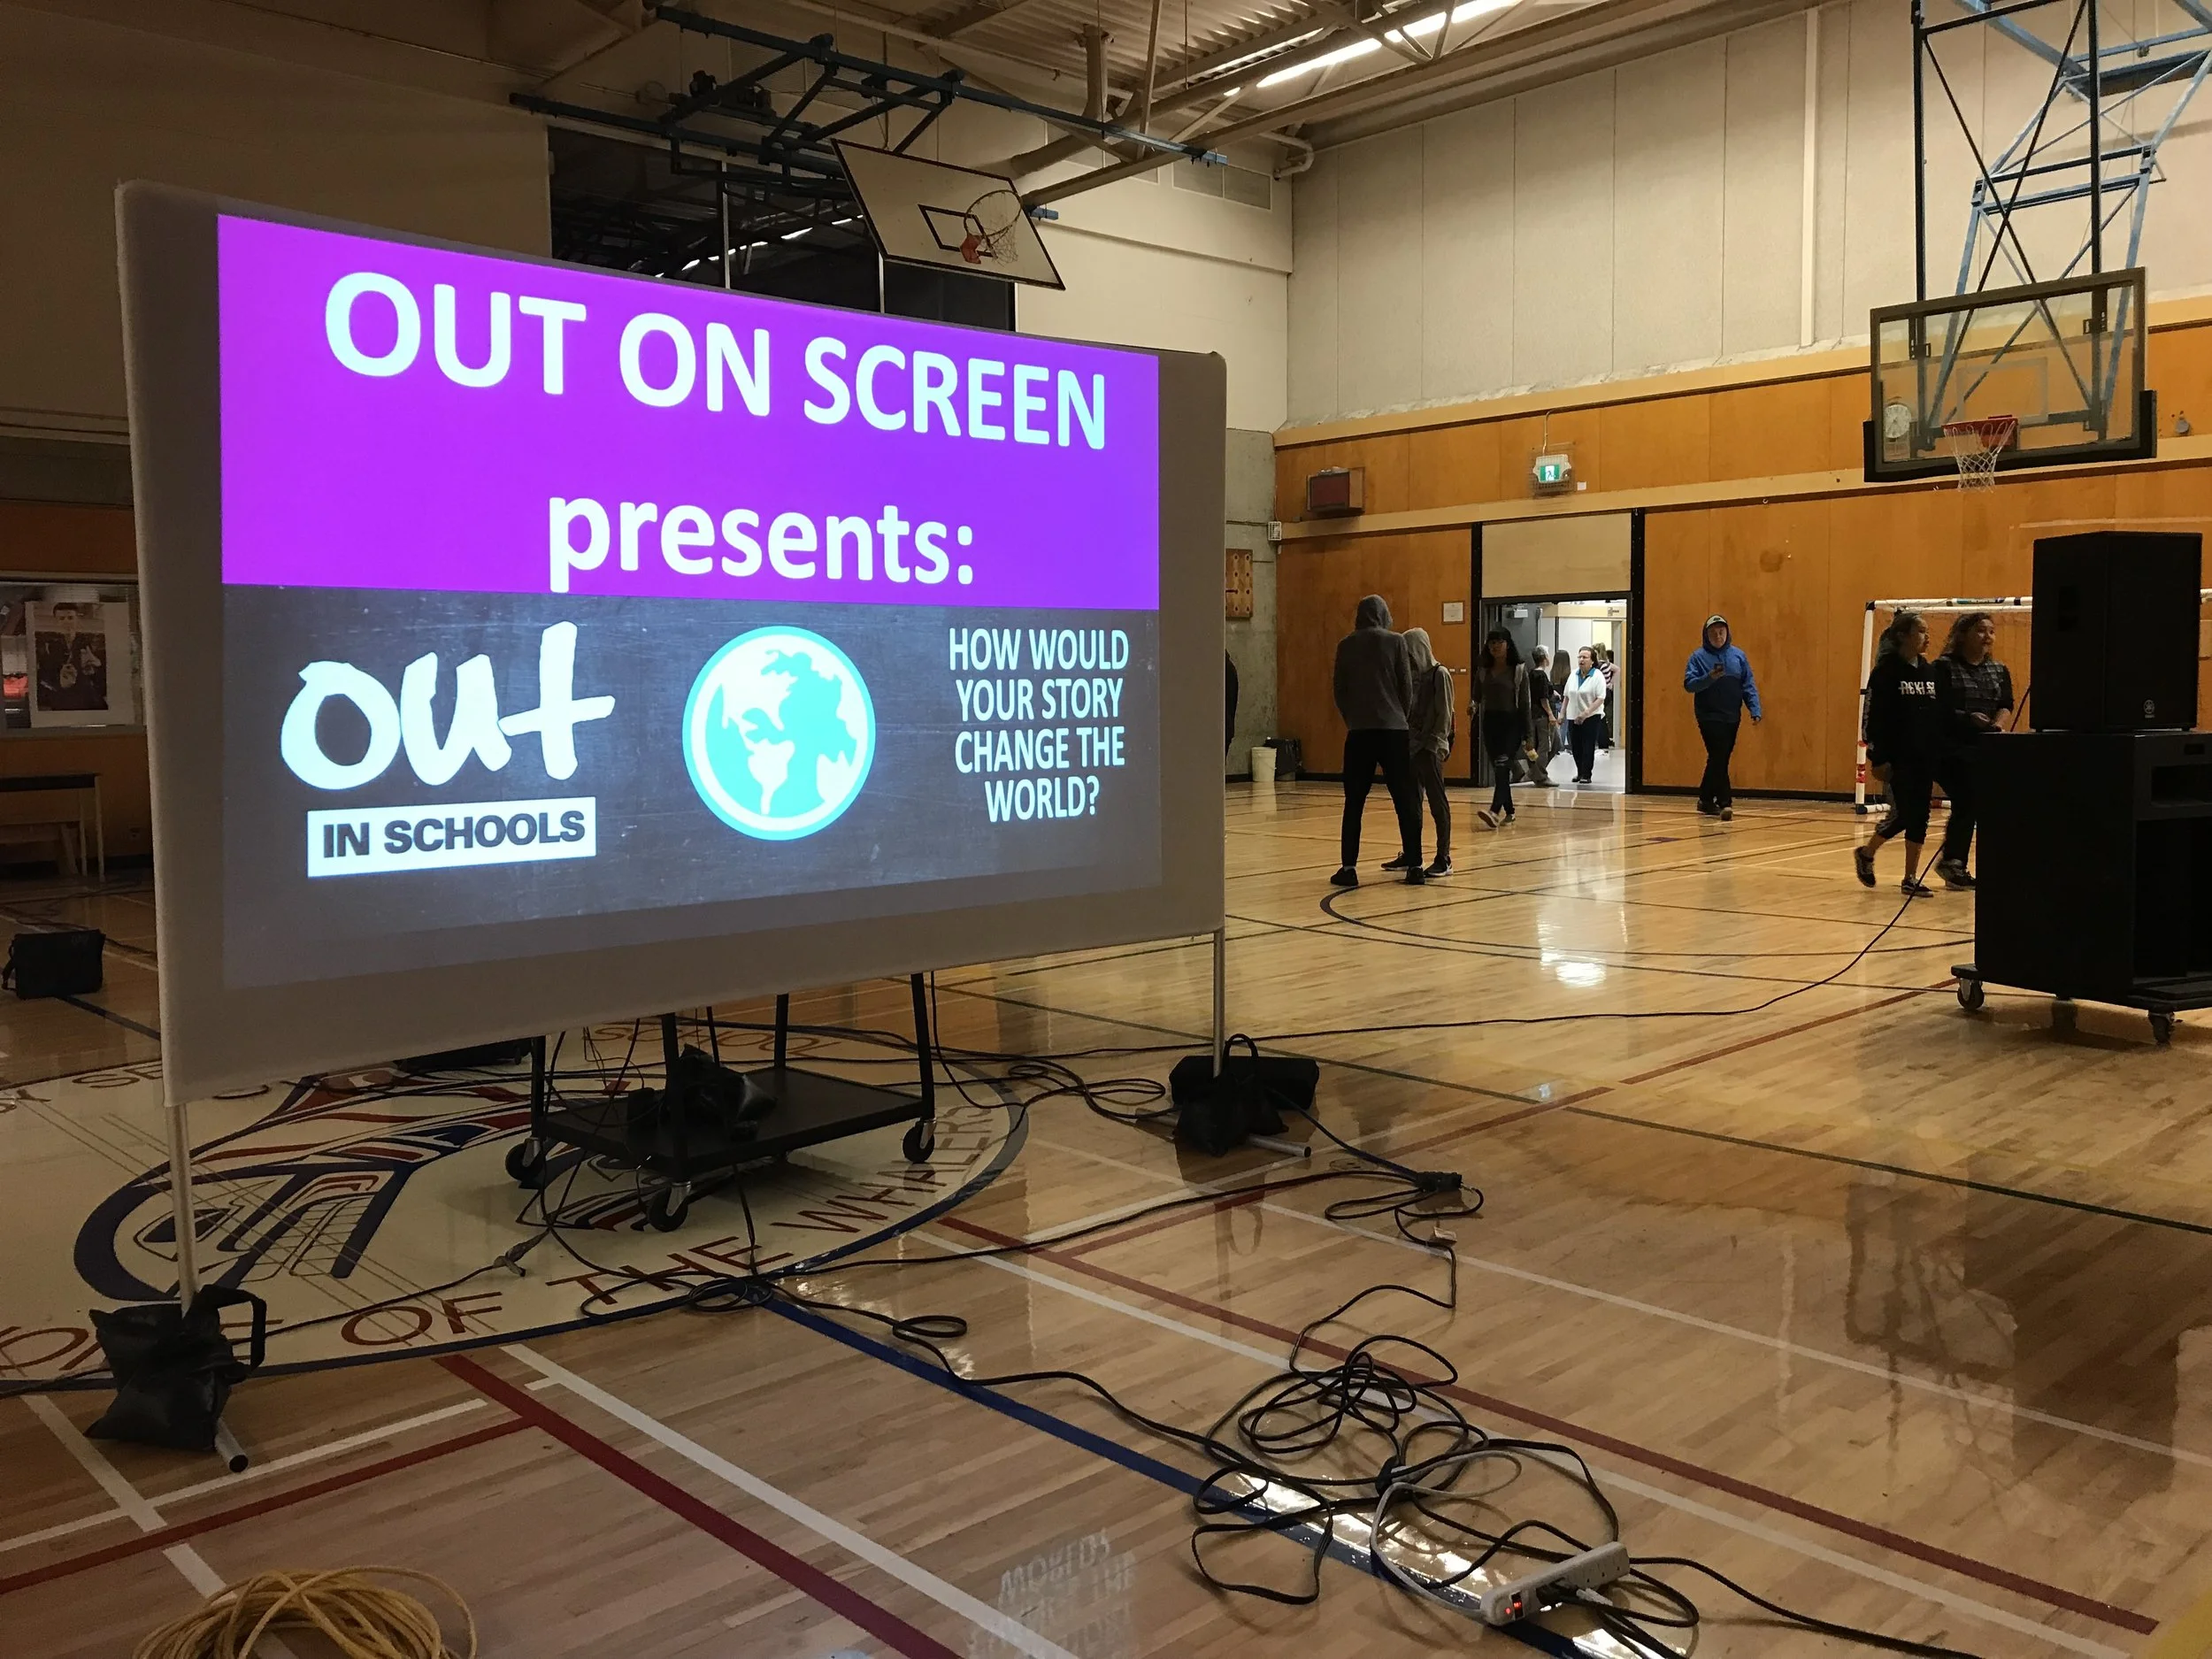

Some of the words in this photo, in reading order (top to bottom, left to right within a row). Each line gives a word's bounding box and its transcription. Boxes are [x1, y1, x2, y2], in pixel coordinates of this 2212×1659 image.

[326, 273, 587, 395] OUT
[620, 313, 770, 416] ON
[803, 337, 1104, 449] SCREEN
[549, 497, 972, 593] presents:
[949, 628, 1021, 670] HOW
[1029, 629, 1128, 670] WOULD
[956, 680, 1034, 721] YOUR
[1042, 679, 1123, 719] STORY
[956, 728, 1069, 773] CHANGE
[1077, 726, 1125, 767] THE
[985, 776, 1099, 822] WORLD?
[325, 823, 369, 857] IN
[385, 811, 585, 853] SCHOOLS
[340, 1292, 503, 1346] OF
[546, 1236, 794, 1305] THE
